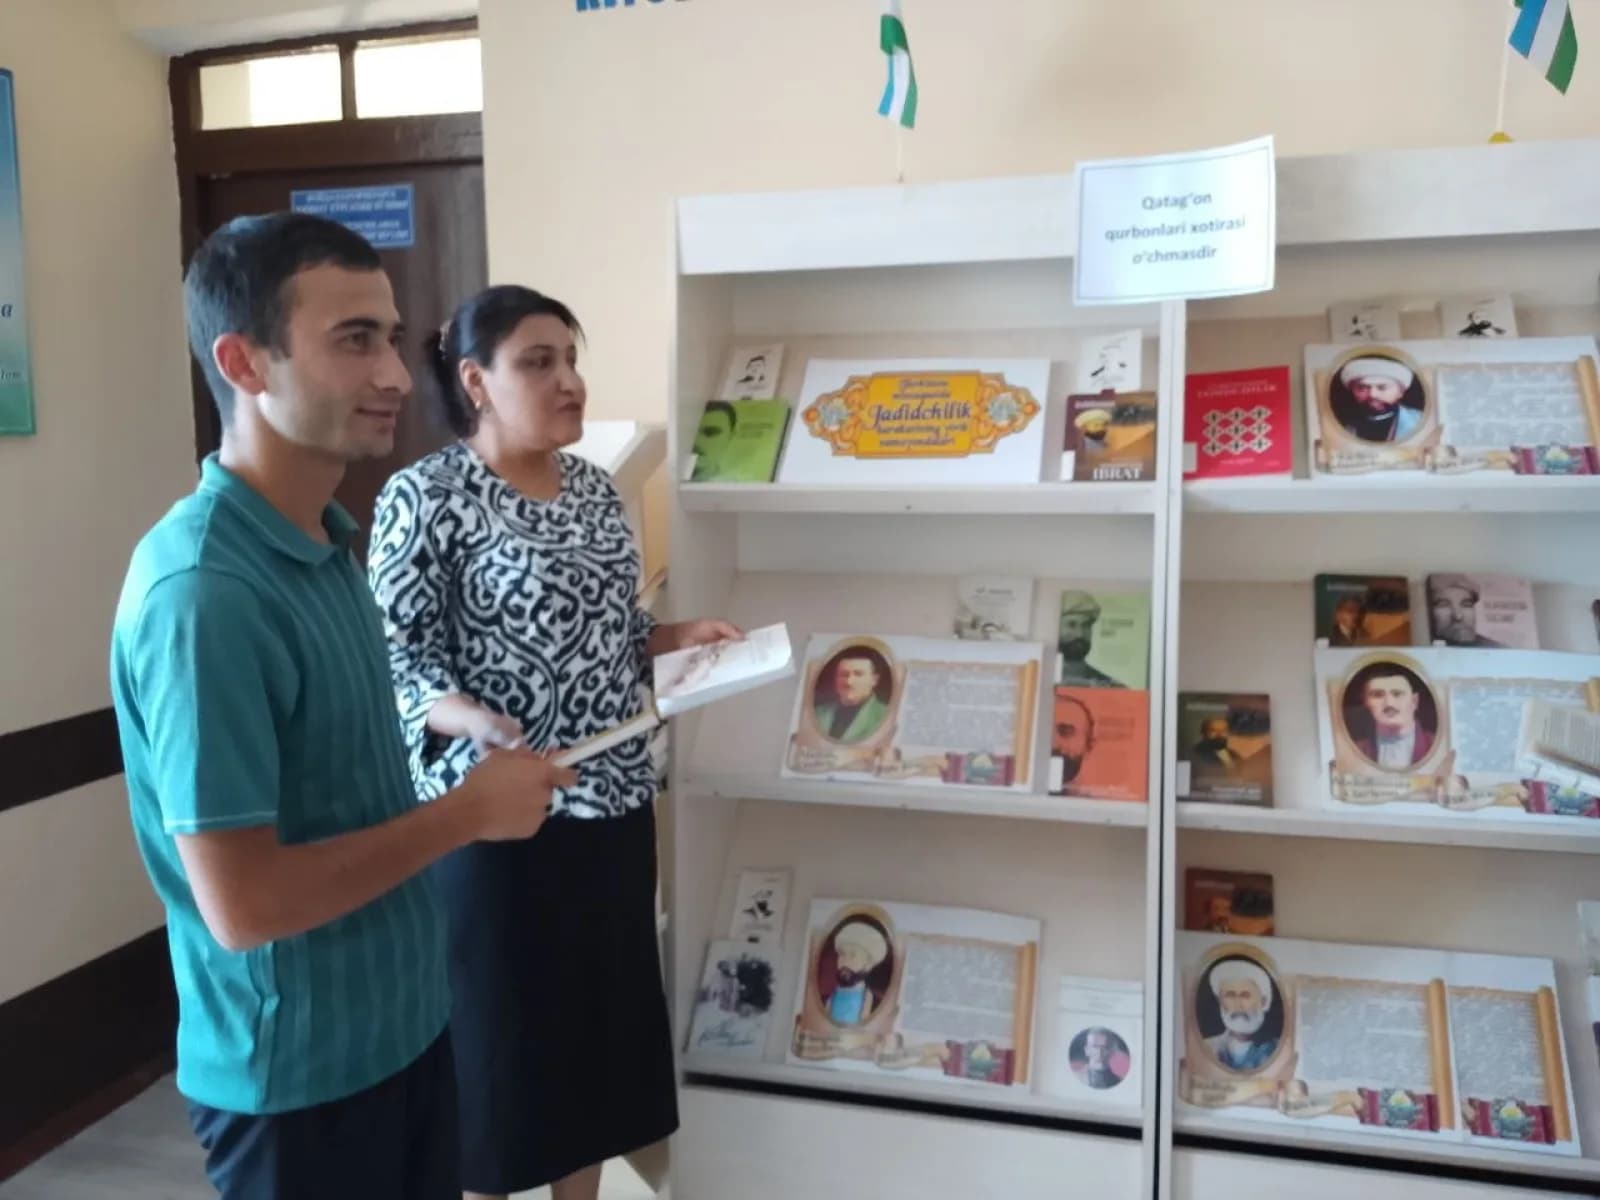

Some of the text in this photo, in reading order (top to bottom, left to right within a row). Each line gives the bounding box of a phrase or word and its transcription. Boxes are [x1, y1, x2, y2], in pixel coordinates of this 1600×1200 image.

[1141, 192, 1212, 211] Qatag'on
[1104, 215, 1247, 243] qurbonlari xotirasi
[1131, 245, 1217, 265] o'chmasdir
[868, 400, 972, 429] Jadidchilik
[1092, 467, 1142, 480] IBRAT
